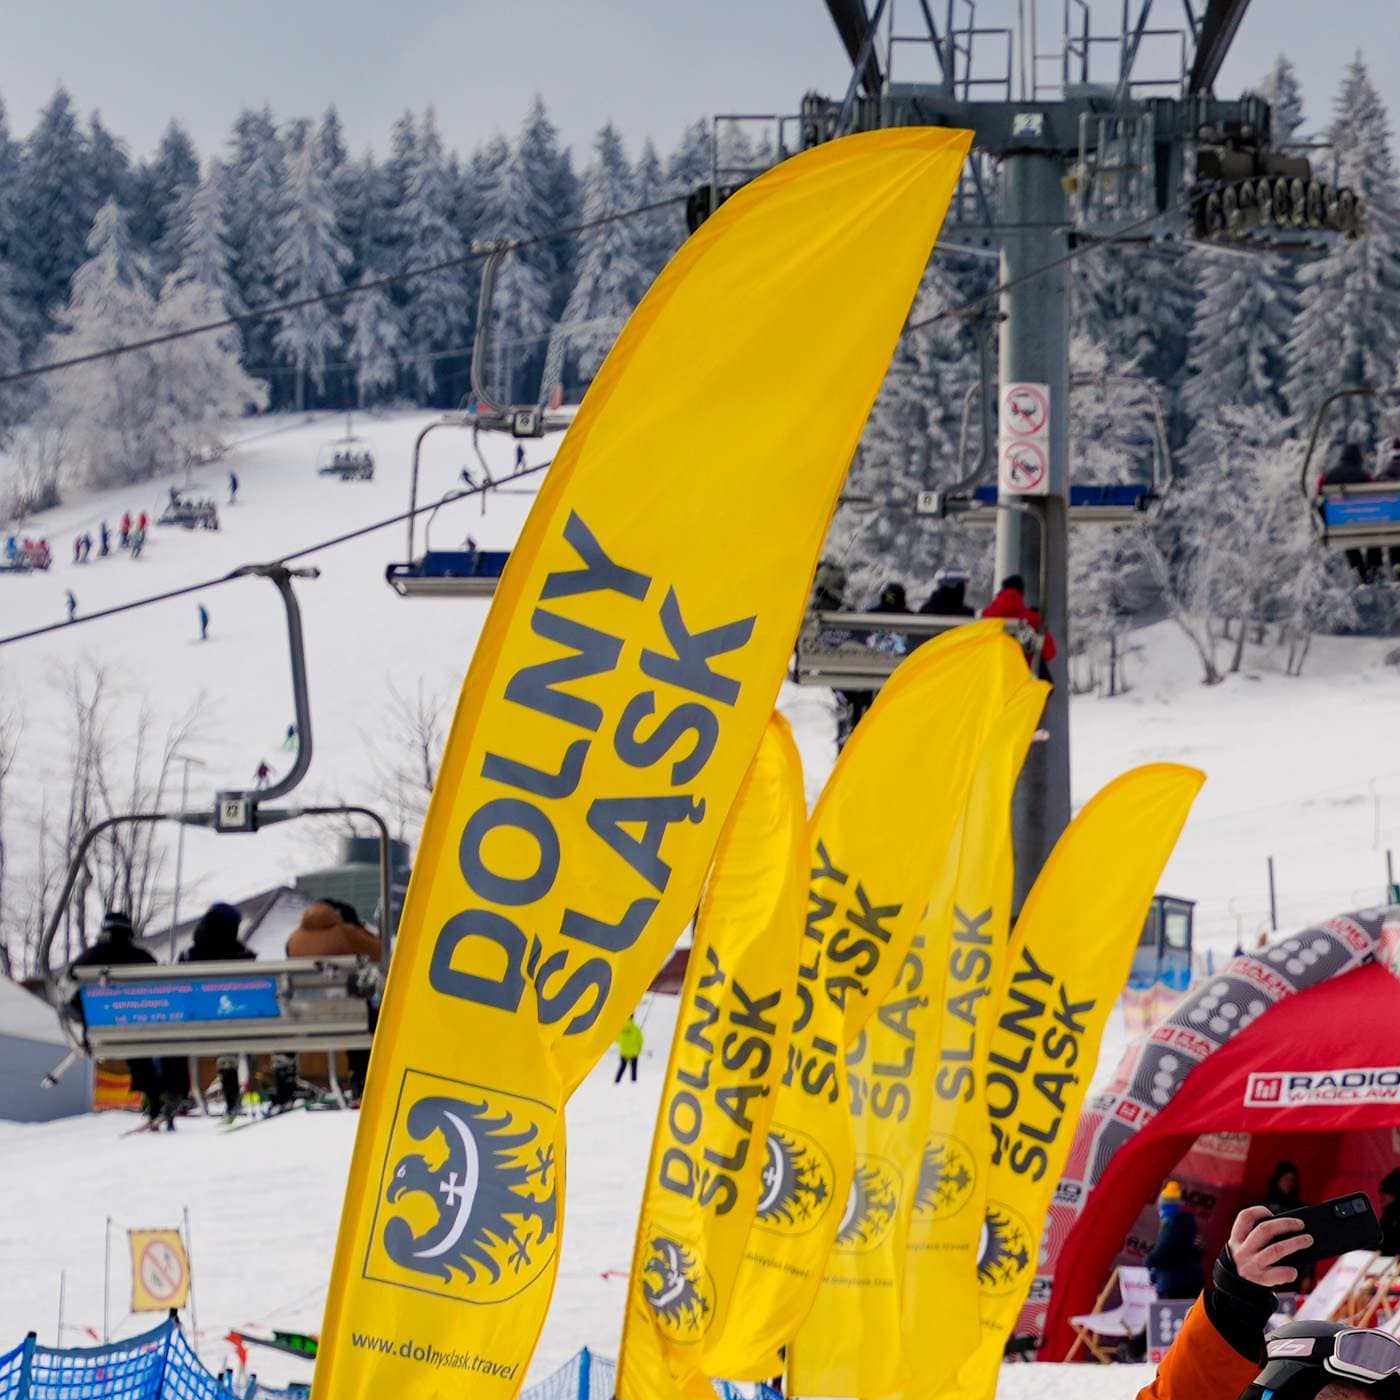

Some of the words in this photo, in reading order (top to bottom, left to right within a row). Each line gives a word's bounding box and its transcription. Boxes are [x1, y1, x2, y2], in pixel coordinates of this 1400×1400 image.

[430, 508, 653, 1013] DOLNY
[526, 584, 758, 1036] ŚLĄSK
[659, 946, 726, 1199] DOLNY
[351, 1331, 520, 1381] www.dolnyslask.travel
